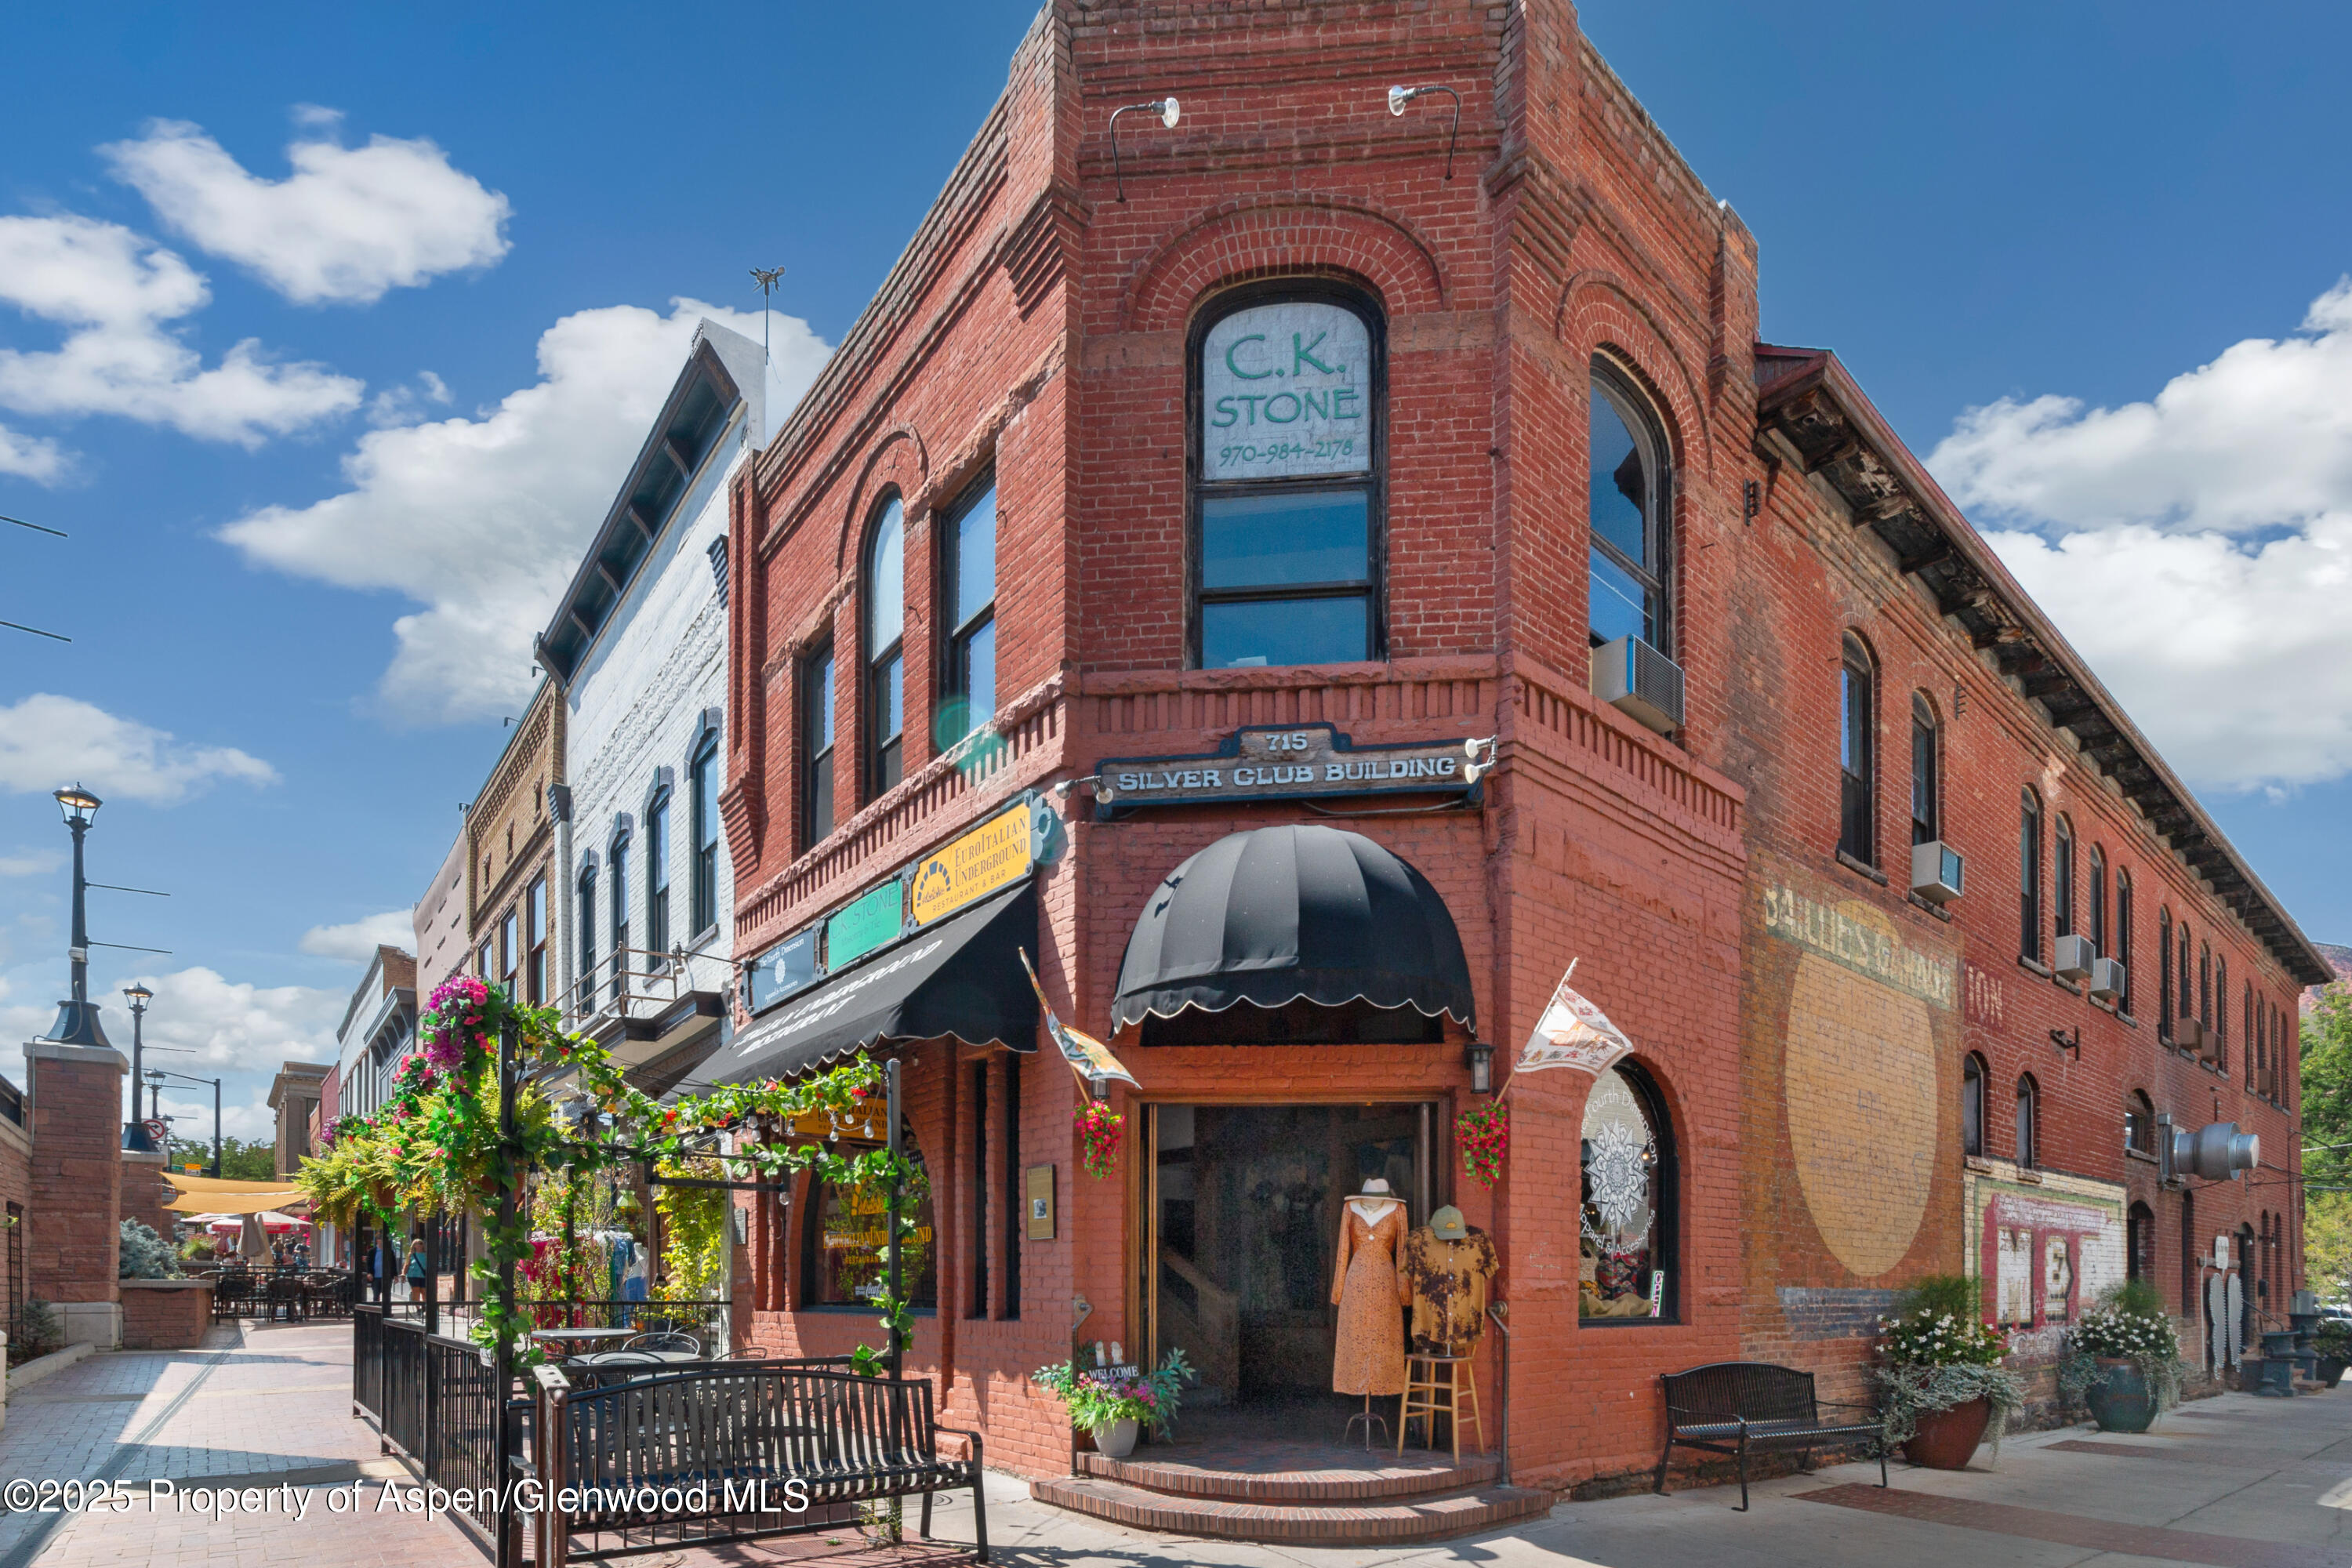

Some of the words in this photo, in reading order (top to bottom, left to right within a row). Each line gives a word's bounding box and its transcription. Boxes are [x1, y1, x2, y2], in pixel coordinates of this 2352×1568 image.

[1226, 332, 1346, 379] C.K.
[1211, 389, 1361, 427] STONE
[1219, 439, 1353, 466] 970-984-2178
[1265, 733, 1308, 751] 715
[1117, 769, 1222, 791] SILVER
[1233, 765, 1315, 786] CLUB
[1324, 757, 1456, 782] BUILDING
[852, 886, 898, 926] STONE
[932, 884, 979, 913] RESTAURANT
[982, 879, 987, 887] &
[990, 869, 1006, 884] BAR
[1621, 1091, 1658, 1165] Dimension
[1615, 1208, 1656, 1256] Accessories
[845, 1254, 881, 1265] RESTAURAN
[1651, 1272, 1663, 1317] OPEN
[1088, 1366, 1139, 1381] WELCOME
